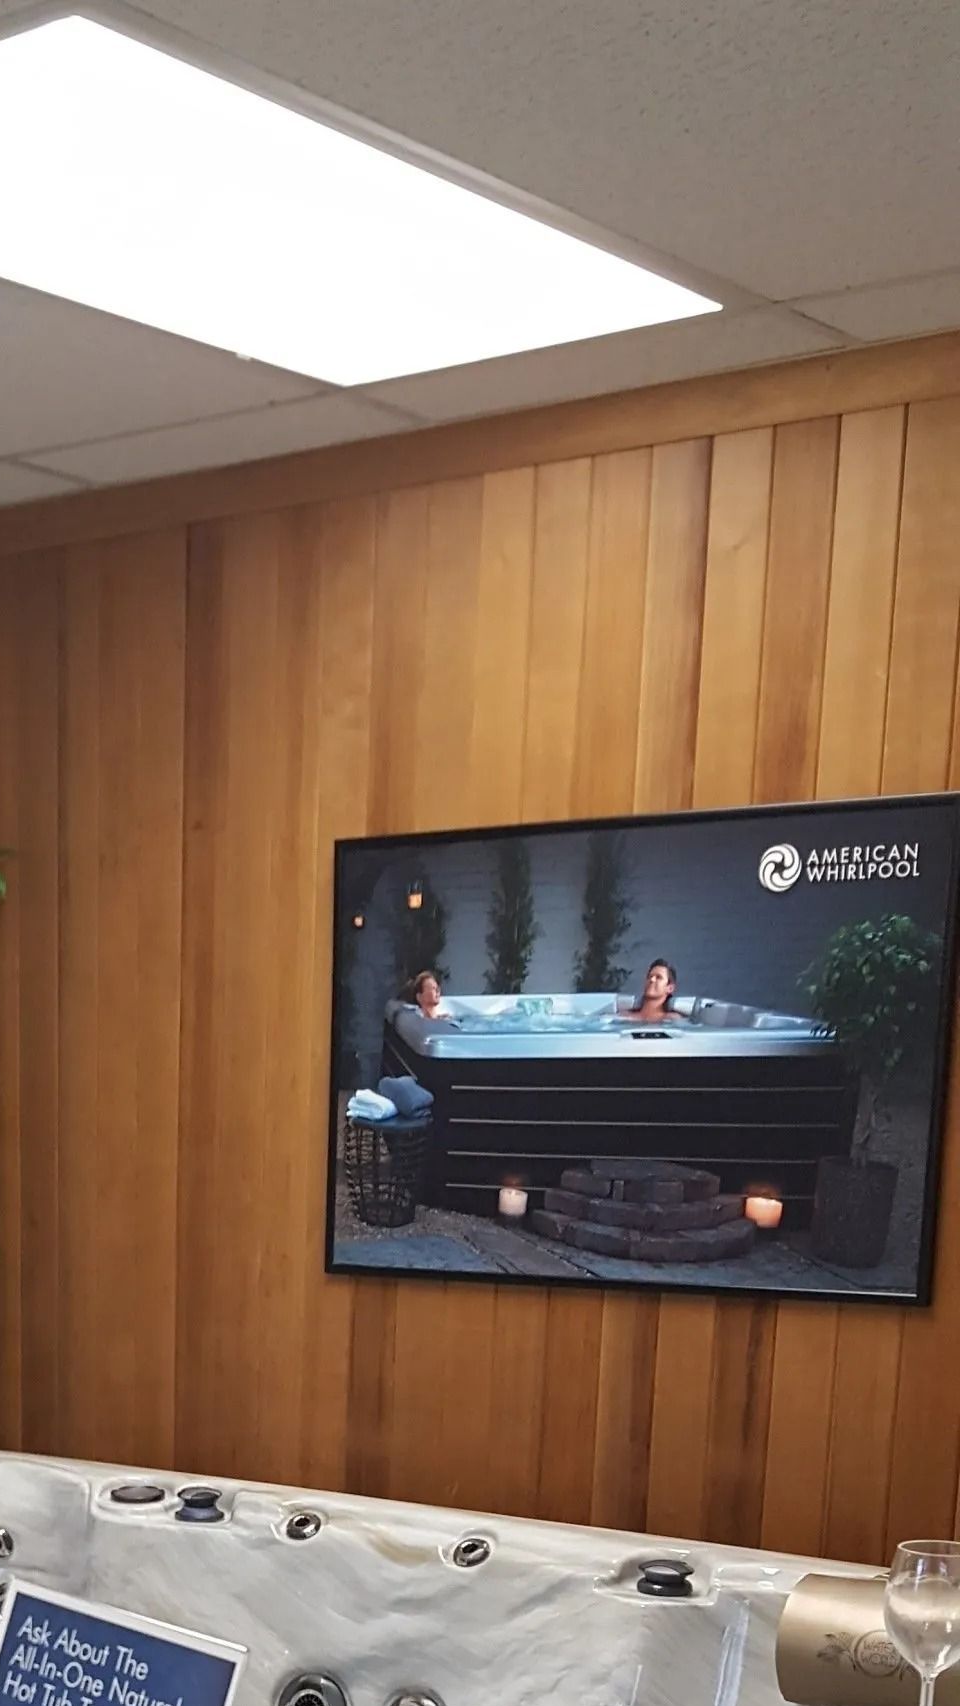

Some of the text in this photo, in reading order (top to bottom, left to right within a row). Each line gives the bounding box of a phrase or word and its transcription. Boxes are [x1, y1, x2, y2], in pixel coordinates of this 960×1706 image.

[806, 843, 919, 865] AMERICAN
[806, 861, 920, 882] WHIRLPOOL
[17, 1615, 149, 1681] Ask About The
[2, 1670, 37, 1704] Hot
[8, 1644, 104, 1697] All-In-One
